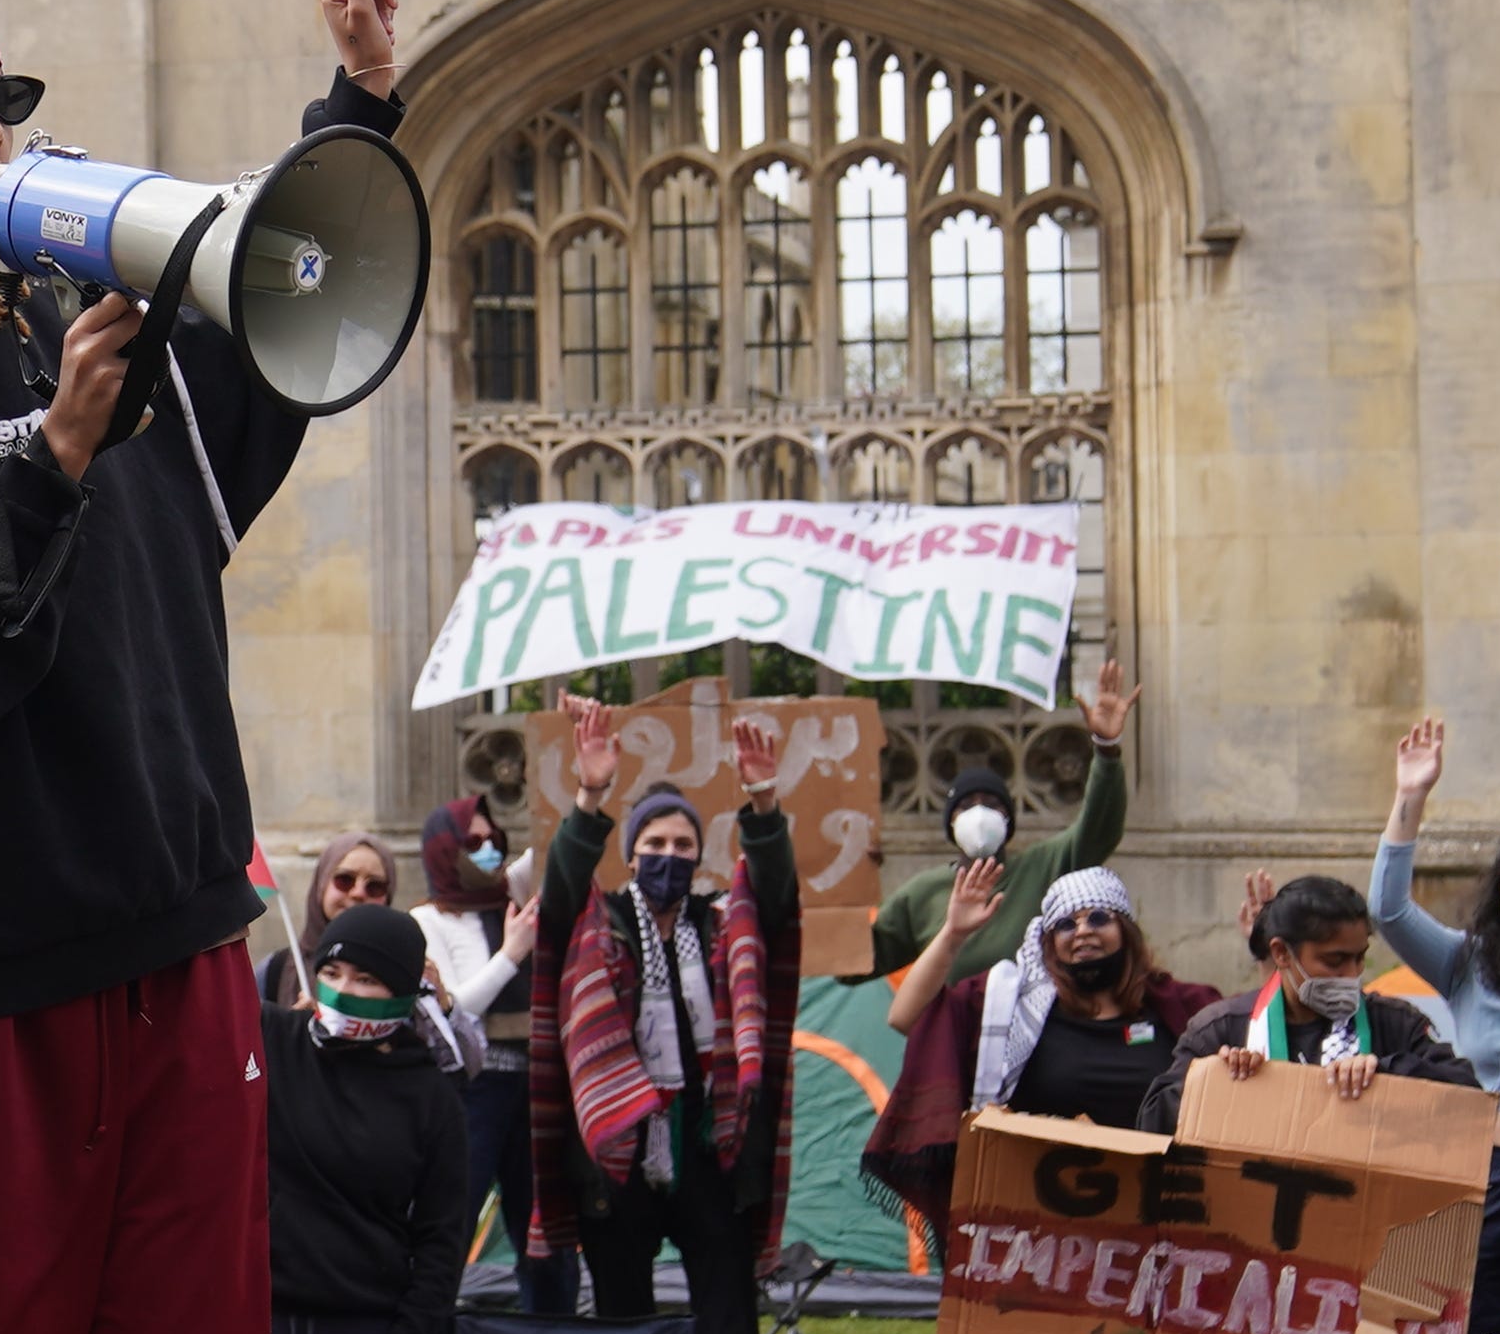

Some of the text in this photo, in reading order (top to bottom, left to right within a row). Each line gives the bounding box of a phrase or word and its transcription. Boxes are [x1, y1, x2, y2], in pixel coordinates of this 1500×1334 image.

[47, 209, 85, 226] VONYX
[733, 509, 1078, 571] UNIVERSITY
[460, 556, 1064, 701] PALESTINE
[1034, 1147, 1358, 1251] GET
